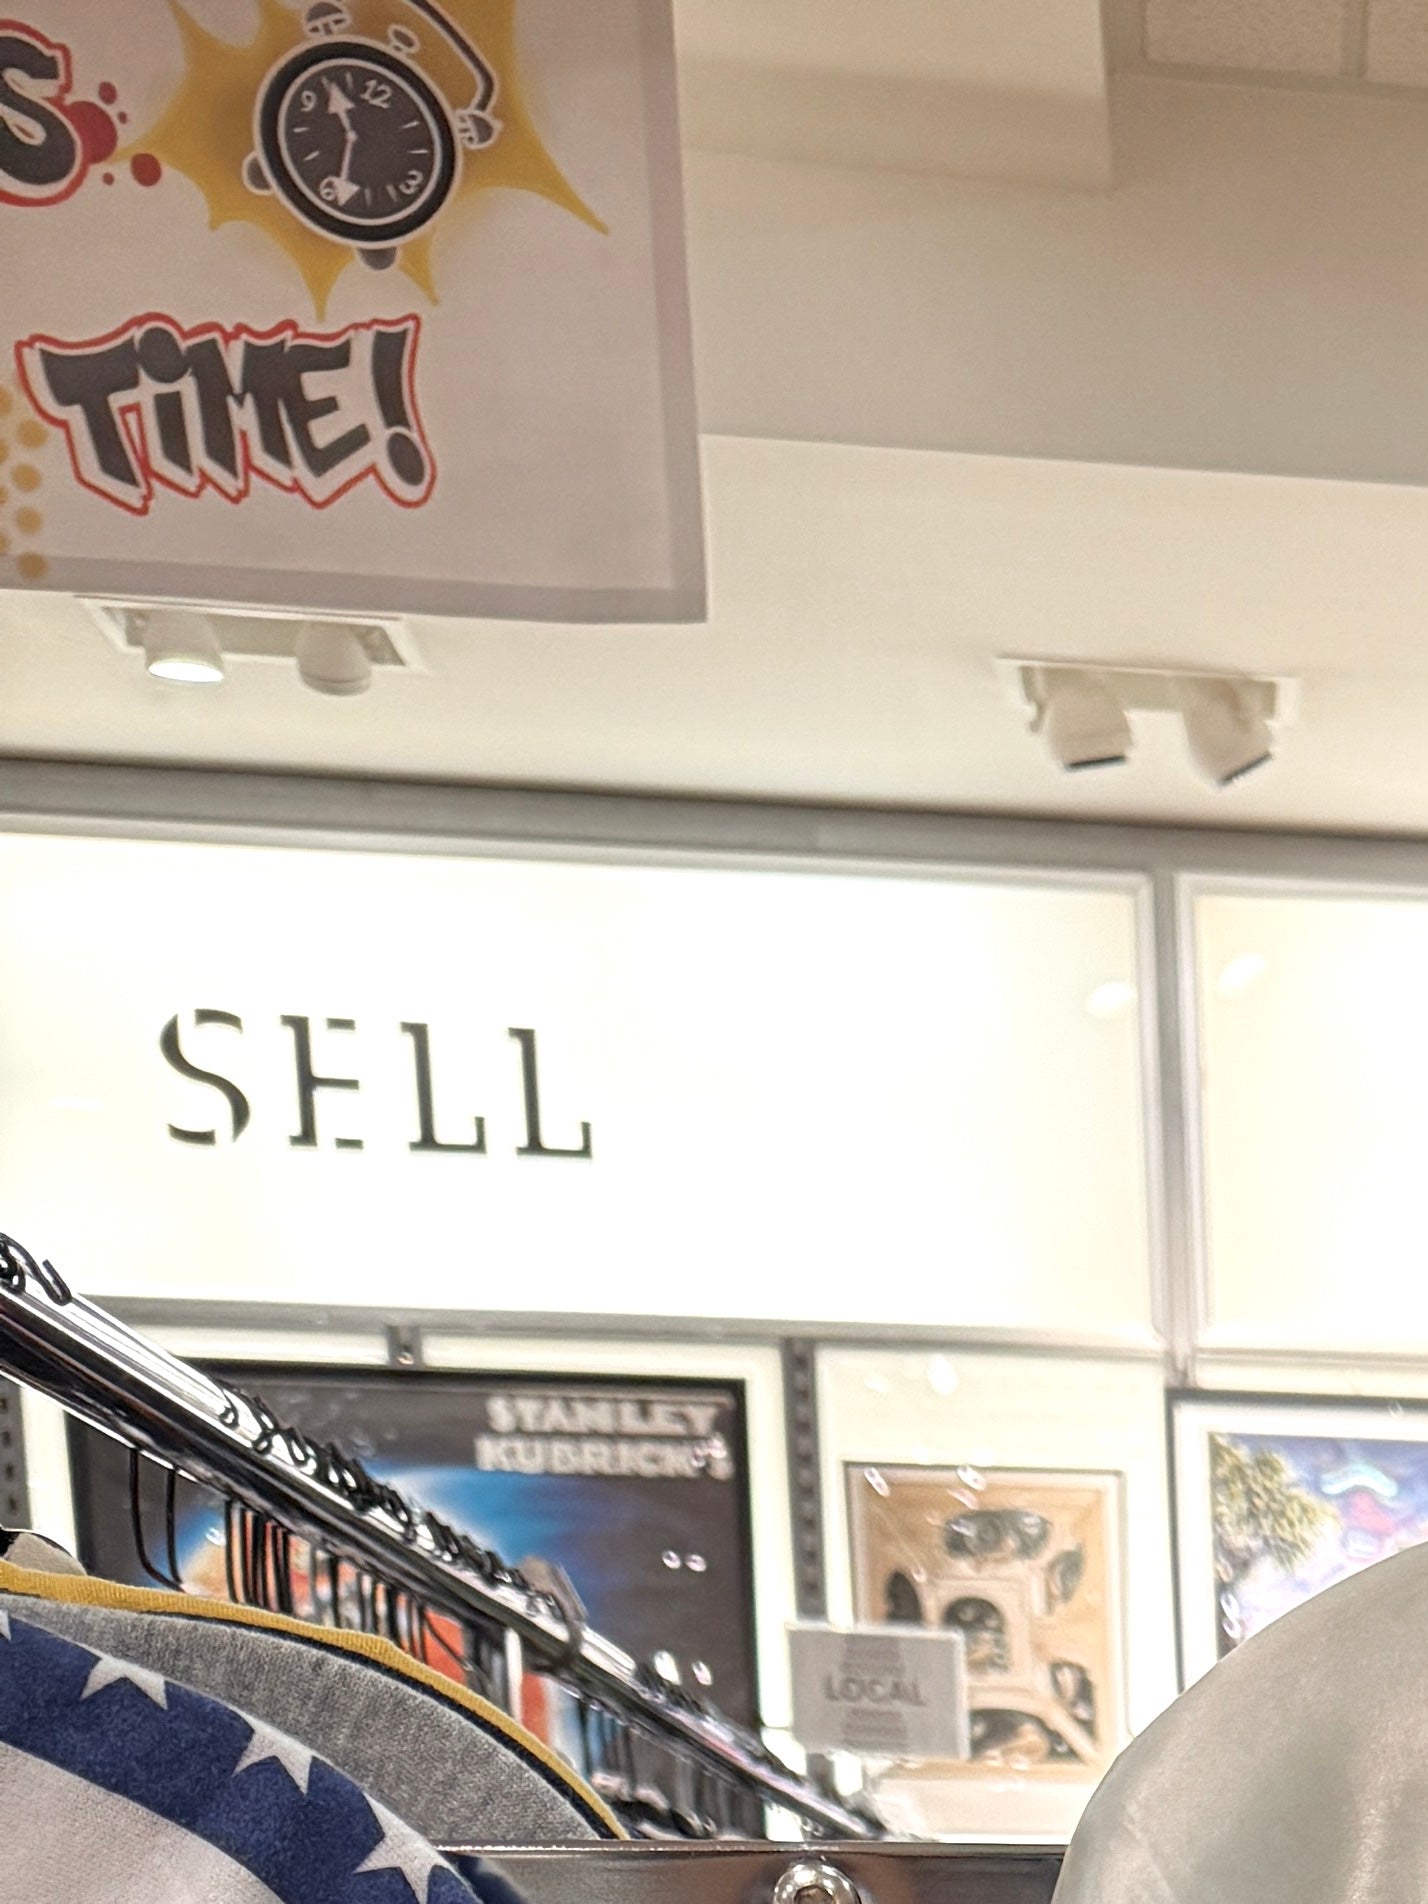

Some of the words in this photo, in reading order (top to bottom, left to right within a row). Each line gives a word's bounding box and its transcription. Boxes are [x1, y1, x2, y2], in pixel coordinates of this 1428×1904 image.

[160, 1008, 592, 1157] SELL
[487, 1397, 719, 1436] STANLEY
[822, 1674, 927, 1707] LOCAL
